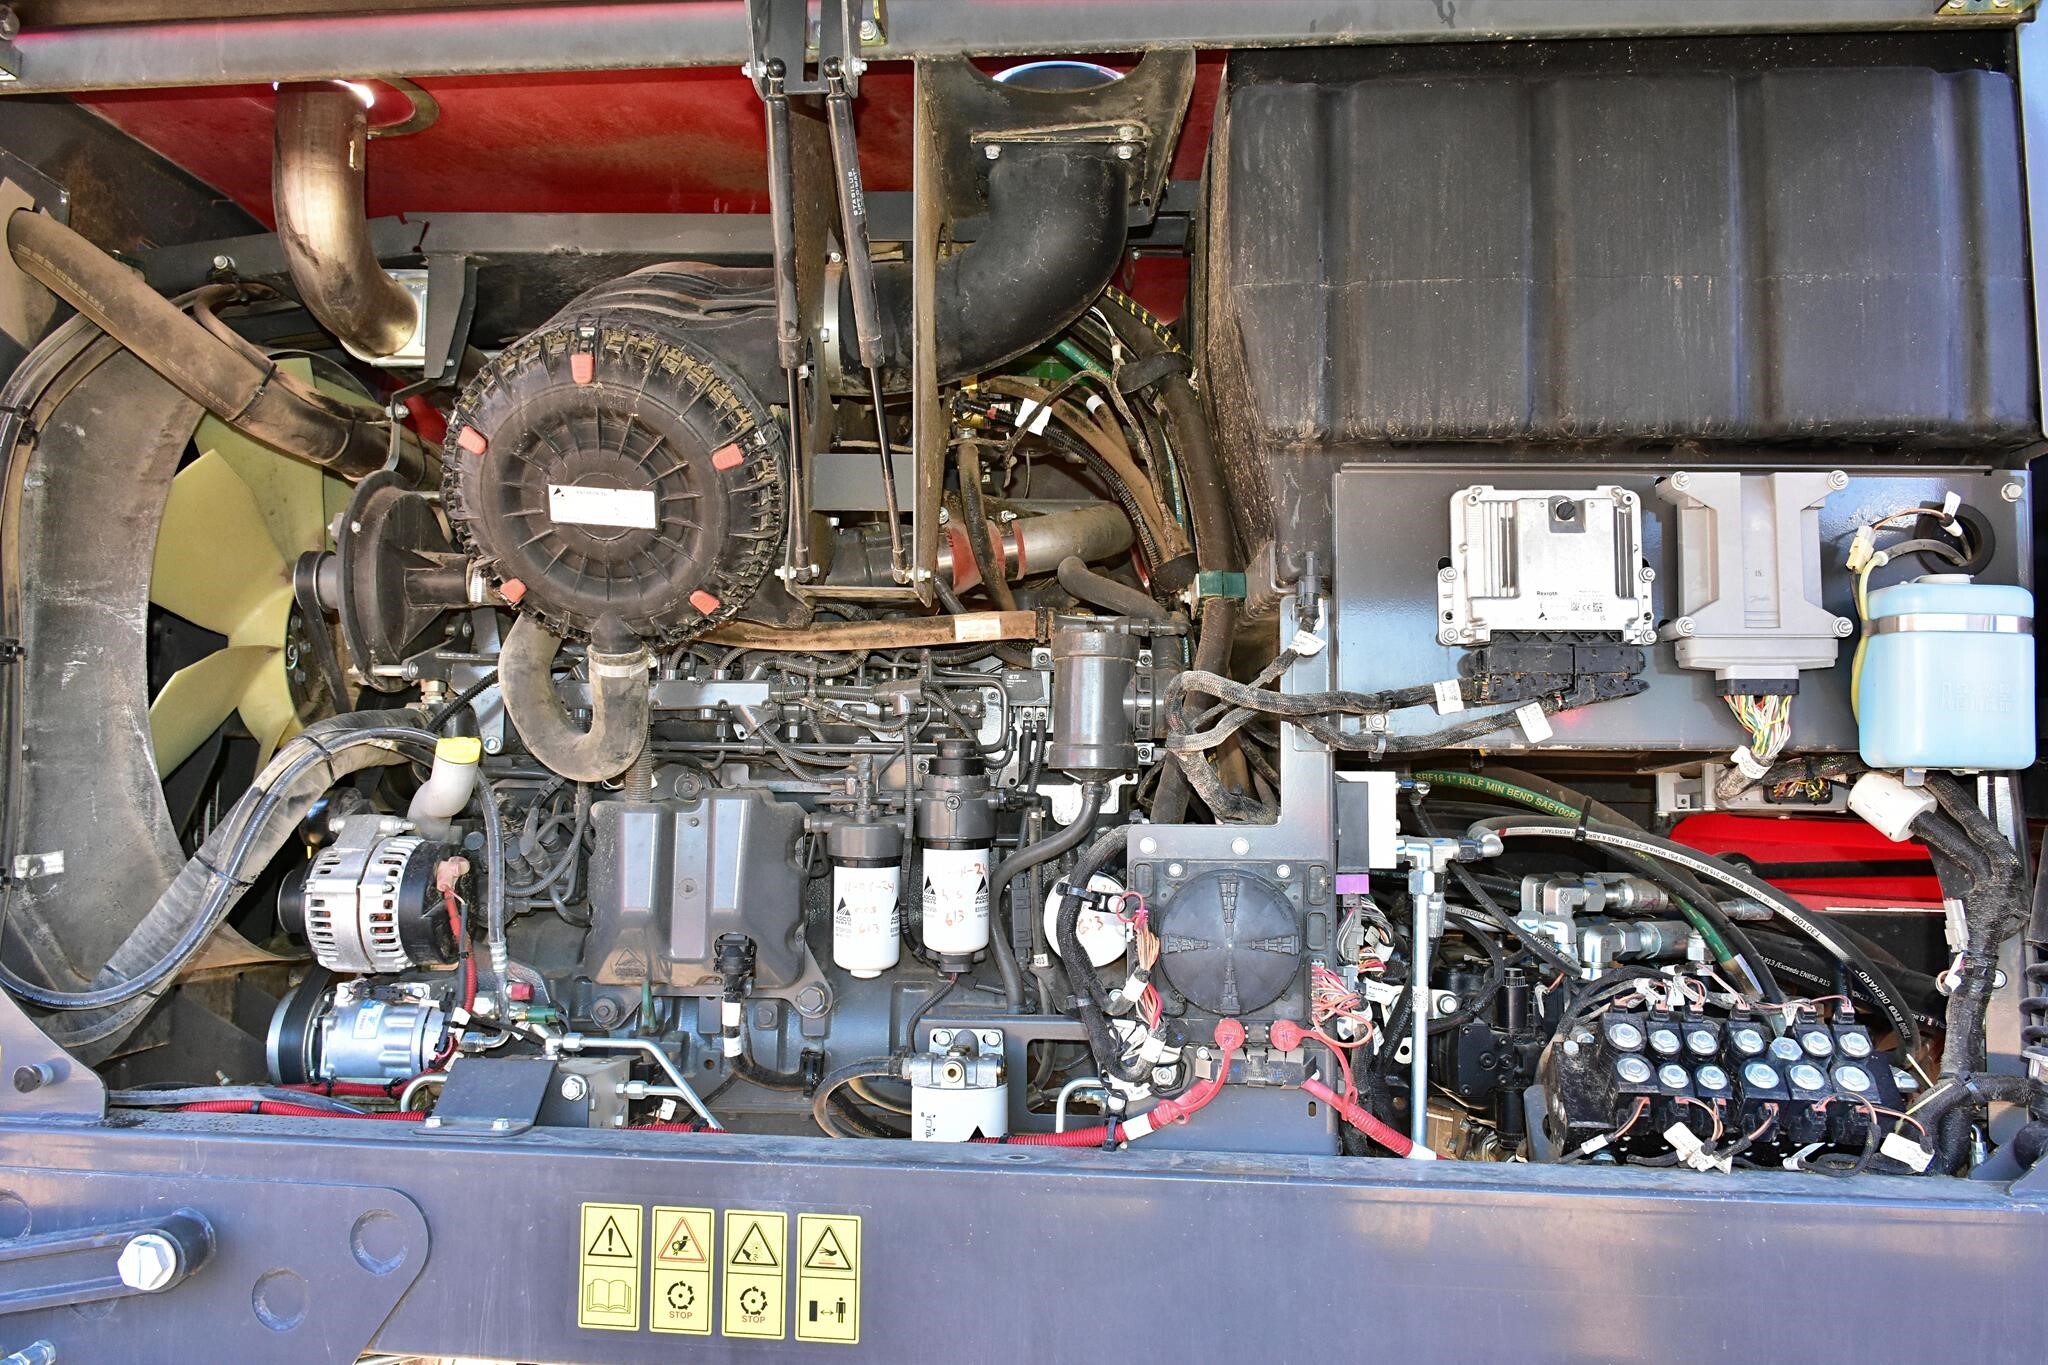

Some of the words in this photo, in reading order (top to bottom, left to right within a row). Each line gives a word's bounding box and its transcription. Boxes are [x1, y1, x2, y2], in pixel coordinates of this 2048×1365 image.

[848, 171, 859, 217] STABILUS
[1459, 777, 1484, 788] HALF
[1486, 782, 1504, 794] MIN
[1506, 788, 1534, 804] BEND
[1696, 864, 1709, 873] BAR
[1859, 971, 1891, 1005] DIEHARD
[669, 1311, 693, 1319] STOP
[742, 1315, 766, 1323] STOP
